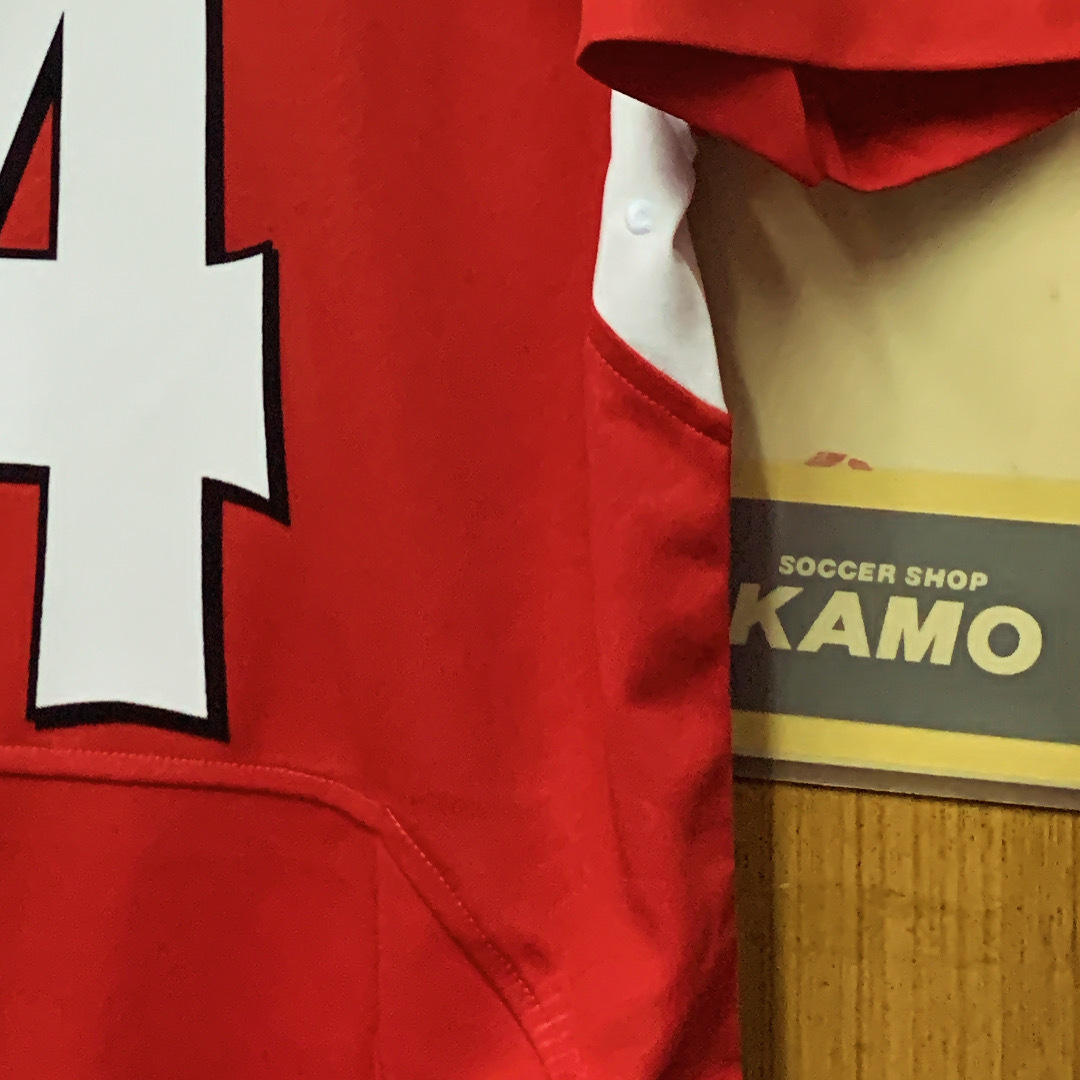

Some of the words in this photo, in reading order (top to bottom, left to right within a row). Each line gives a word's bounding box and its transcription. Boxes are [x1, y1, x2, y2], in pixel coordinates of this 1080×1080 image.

[779, 555, 896, 584] SOCCER
[905, 566, 988, 591] SHOP
[730, 583, 1043, 675] KAMO
